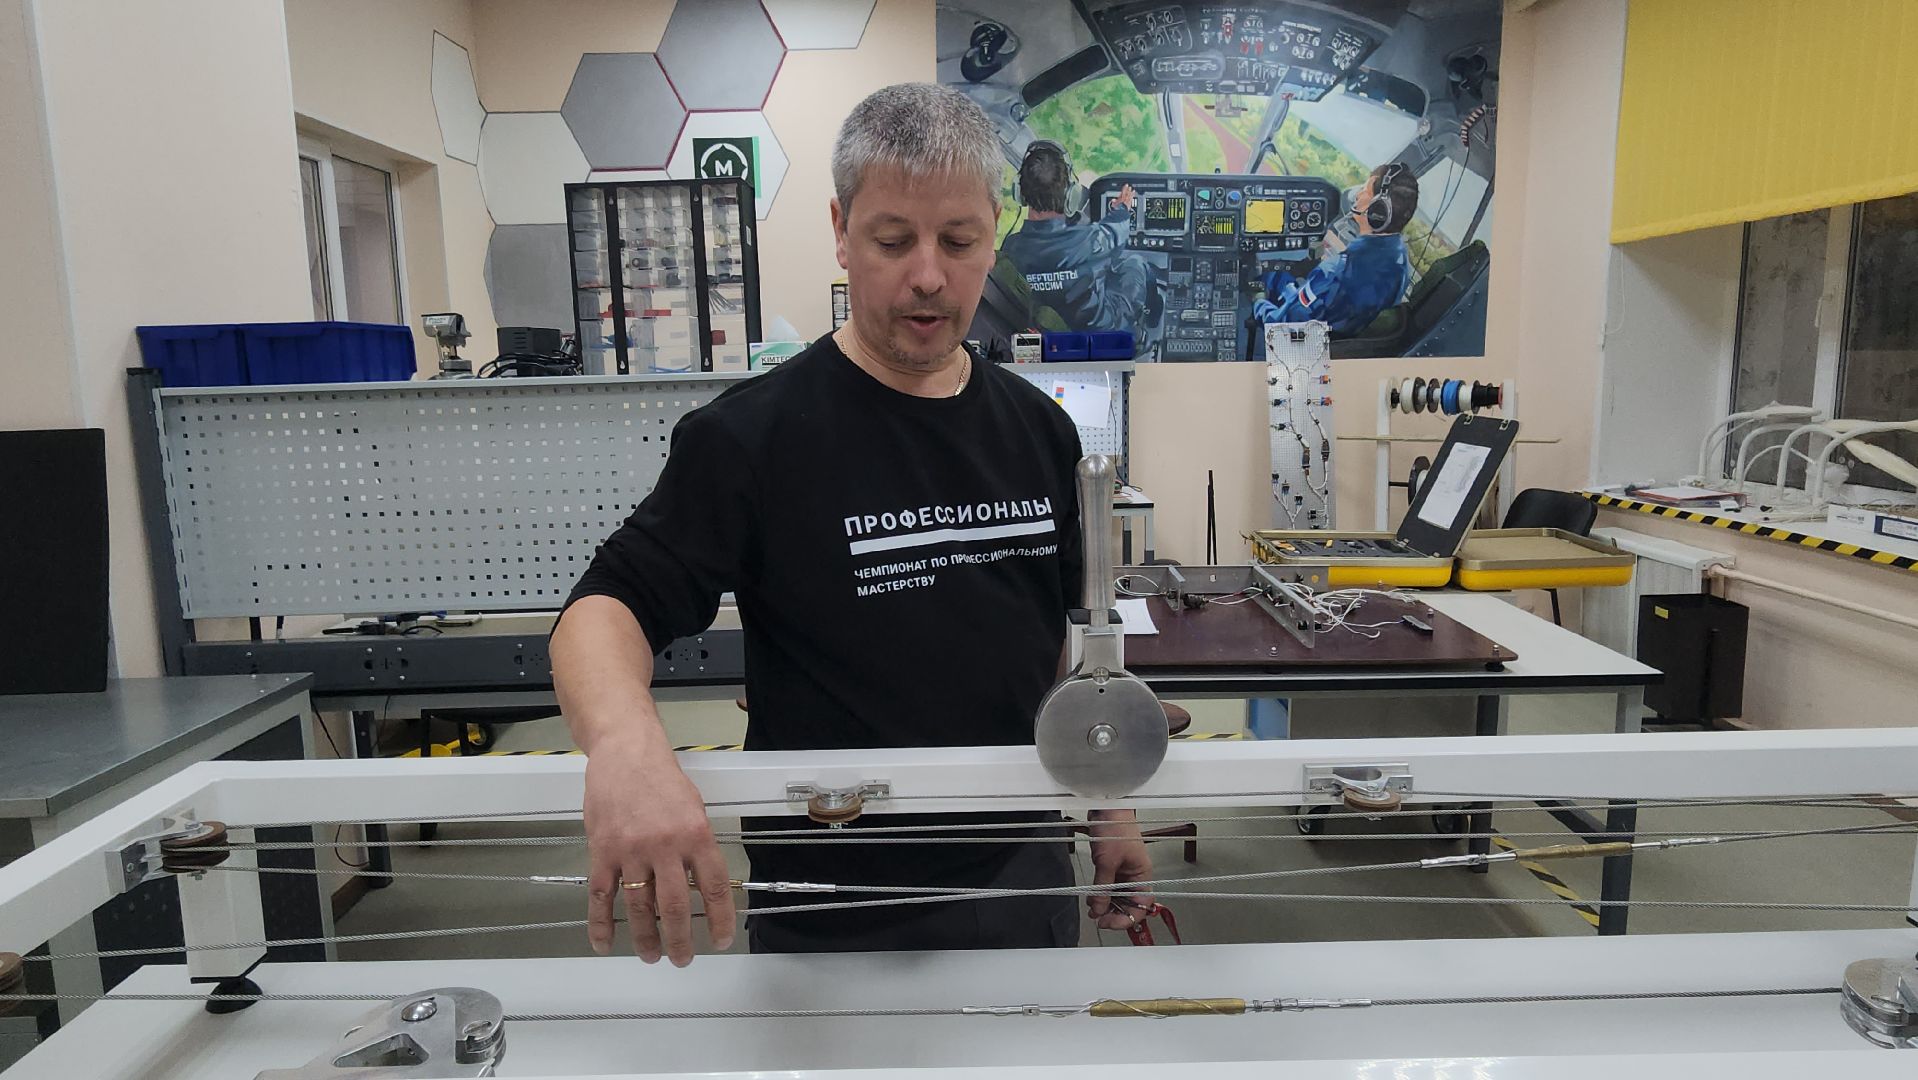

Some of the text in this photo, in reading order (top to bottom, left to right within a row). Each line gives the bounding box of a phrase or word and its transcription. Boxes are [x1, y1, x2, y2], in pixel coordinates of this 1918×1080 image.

[1026, 270, 1078, 282] ВЕРТОЛЕТЫ
[844, 497, 1053, 536] ПРОФЕССИОНАЛЫ
[854, 559, 927, 580] ЧЕМПИОНАТ
[931, 556, 948, 568] ПО
[857, 574, 936, 597] МАСТЕРСТВУ
